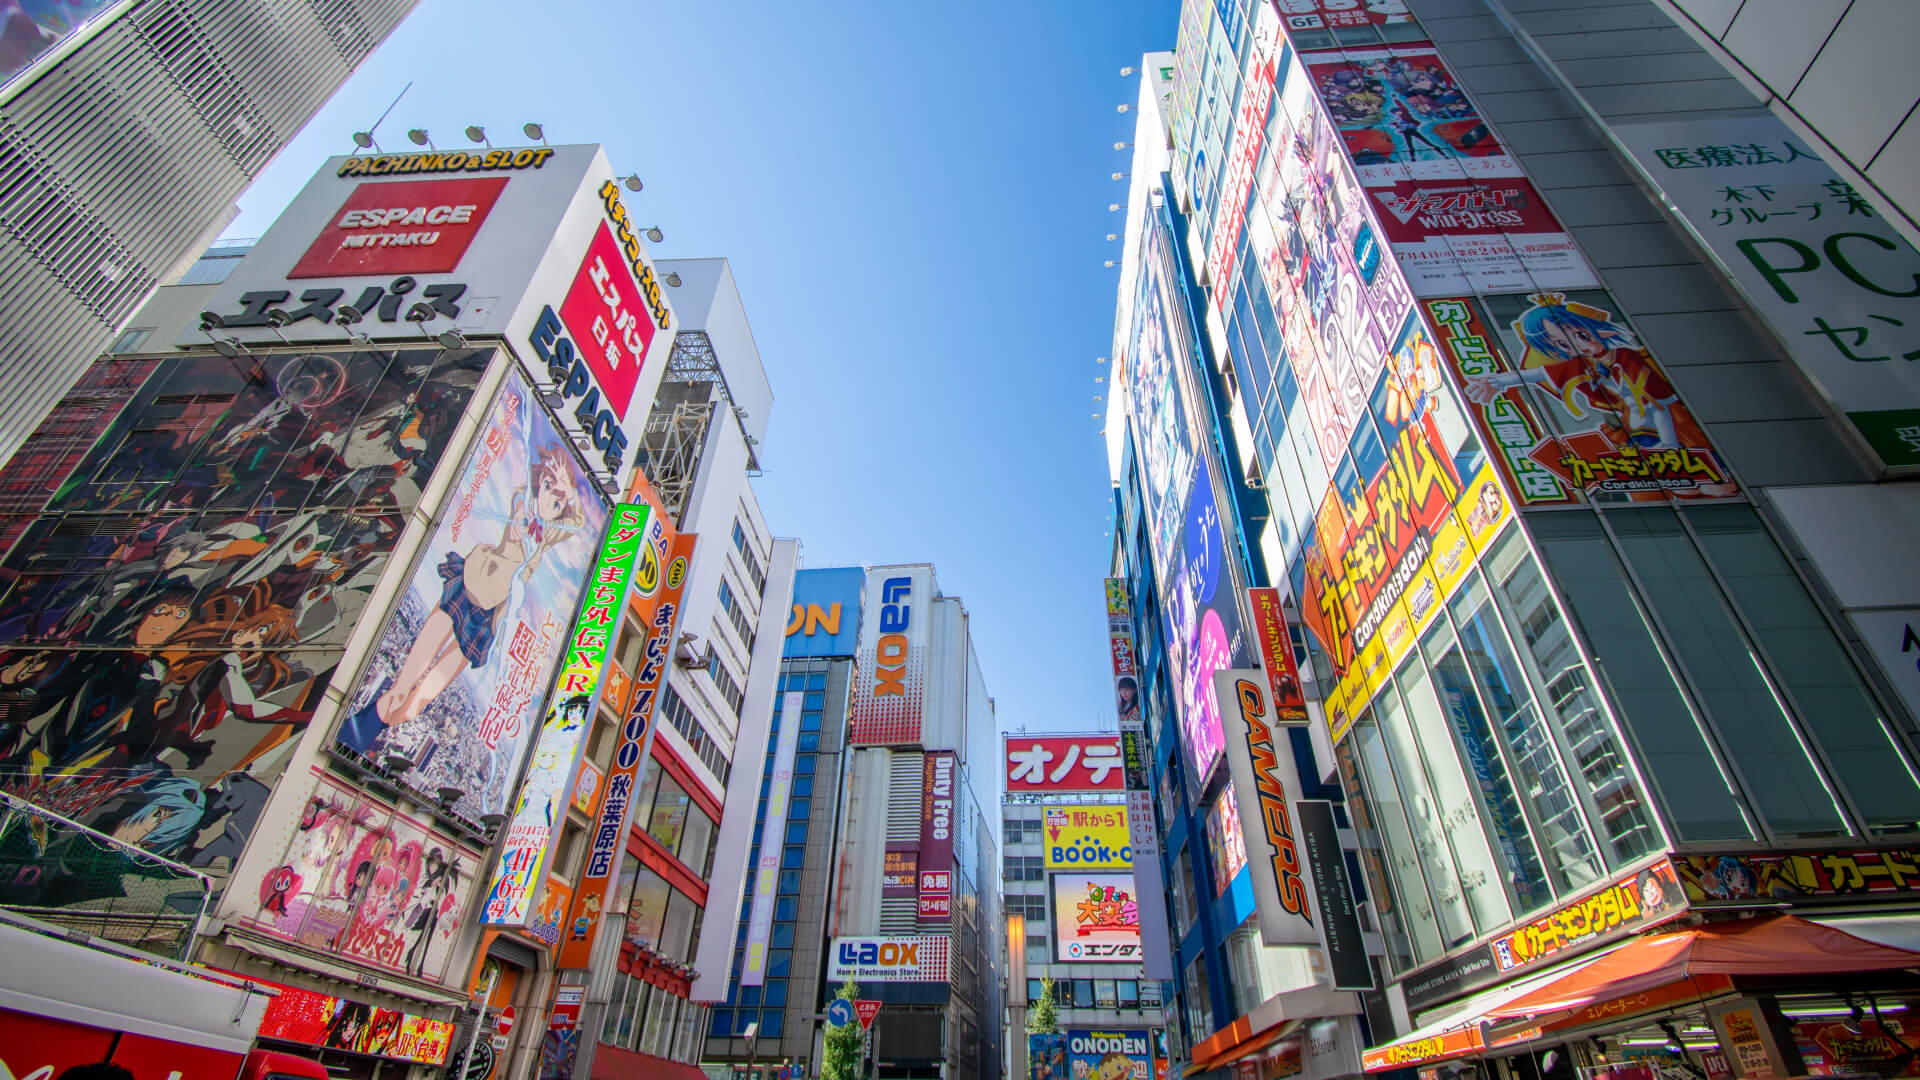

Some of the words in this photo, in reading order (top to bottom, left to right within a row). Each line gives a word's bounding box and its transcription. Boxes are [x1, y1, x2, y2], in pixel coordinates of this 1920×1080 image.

[1292, 16, 1319, 27] 6F
[337, 150, 552, 177] PACHINKO&SLOT
[1655, 141, 1824, 169] 医療法人
[1717, 184, 1776, 203] 木下
[337, 205, 477, 228] ESPACE
[1710, 202, 1822, 226] グループ
[342, 231, 439, 248] NITTAKU
[223, 276, 467, 327] エスパス
[588, 255, 645, 366] エスパス
[530, 305, 628, 464] ESPACE
[1562, 449, 1722, 488] カードキングダム
[1318, 427, 1459, 670] カードキングダム
[565, 510, 640, 692] Sダンまち外伝XR
[478, 620, 537, 750] 超電磁砲
[505, 611, 555, 739] とある科学の
[617, 689, 654, 770] ZOO
[933, 756, 953, 797] Duty
[925, 795, 934, 820] Store
[933, 799, 951, 840] Free
[1236, 679, 1315, 930] GAMERS
[586, 773, 632, 878] 秋葉原店
[507, 847, 538, 872] 4F
[1308, 831, 1319, 859] AKIBA
[499, 874, 526, 899] 6台
[922, 874, 948, 889] 免税
[1821, 852, 1920, 890] カード
[921, 899, 948, 912] 면세점
[1526, 886, 1642, 956] カードキングダム
[836, 967, 856, 976] Home
[858, 967, 898, 976] Electronics
[900, 967, 919, 976] Store
[1071, 1038, 1147, 1054] ONODEN
